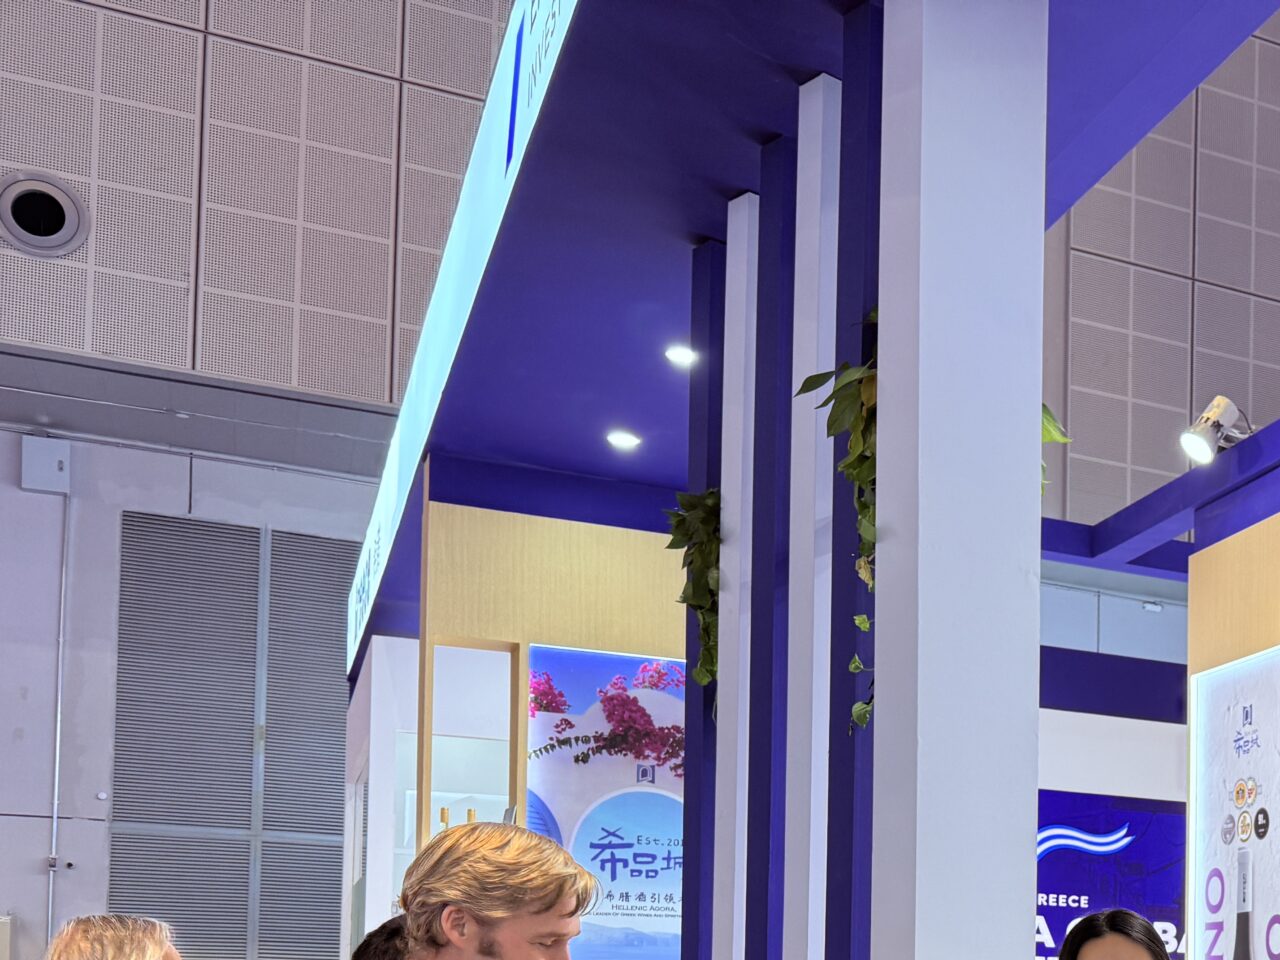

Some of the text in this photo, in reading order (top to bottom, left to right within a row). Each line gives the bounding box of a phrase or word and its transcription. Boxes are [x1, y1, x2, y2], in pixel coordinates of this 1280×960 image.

[605, 890, 683, 904] 希腊酒引领
[1037, 893, 1089, 908] REECE
